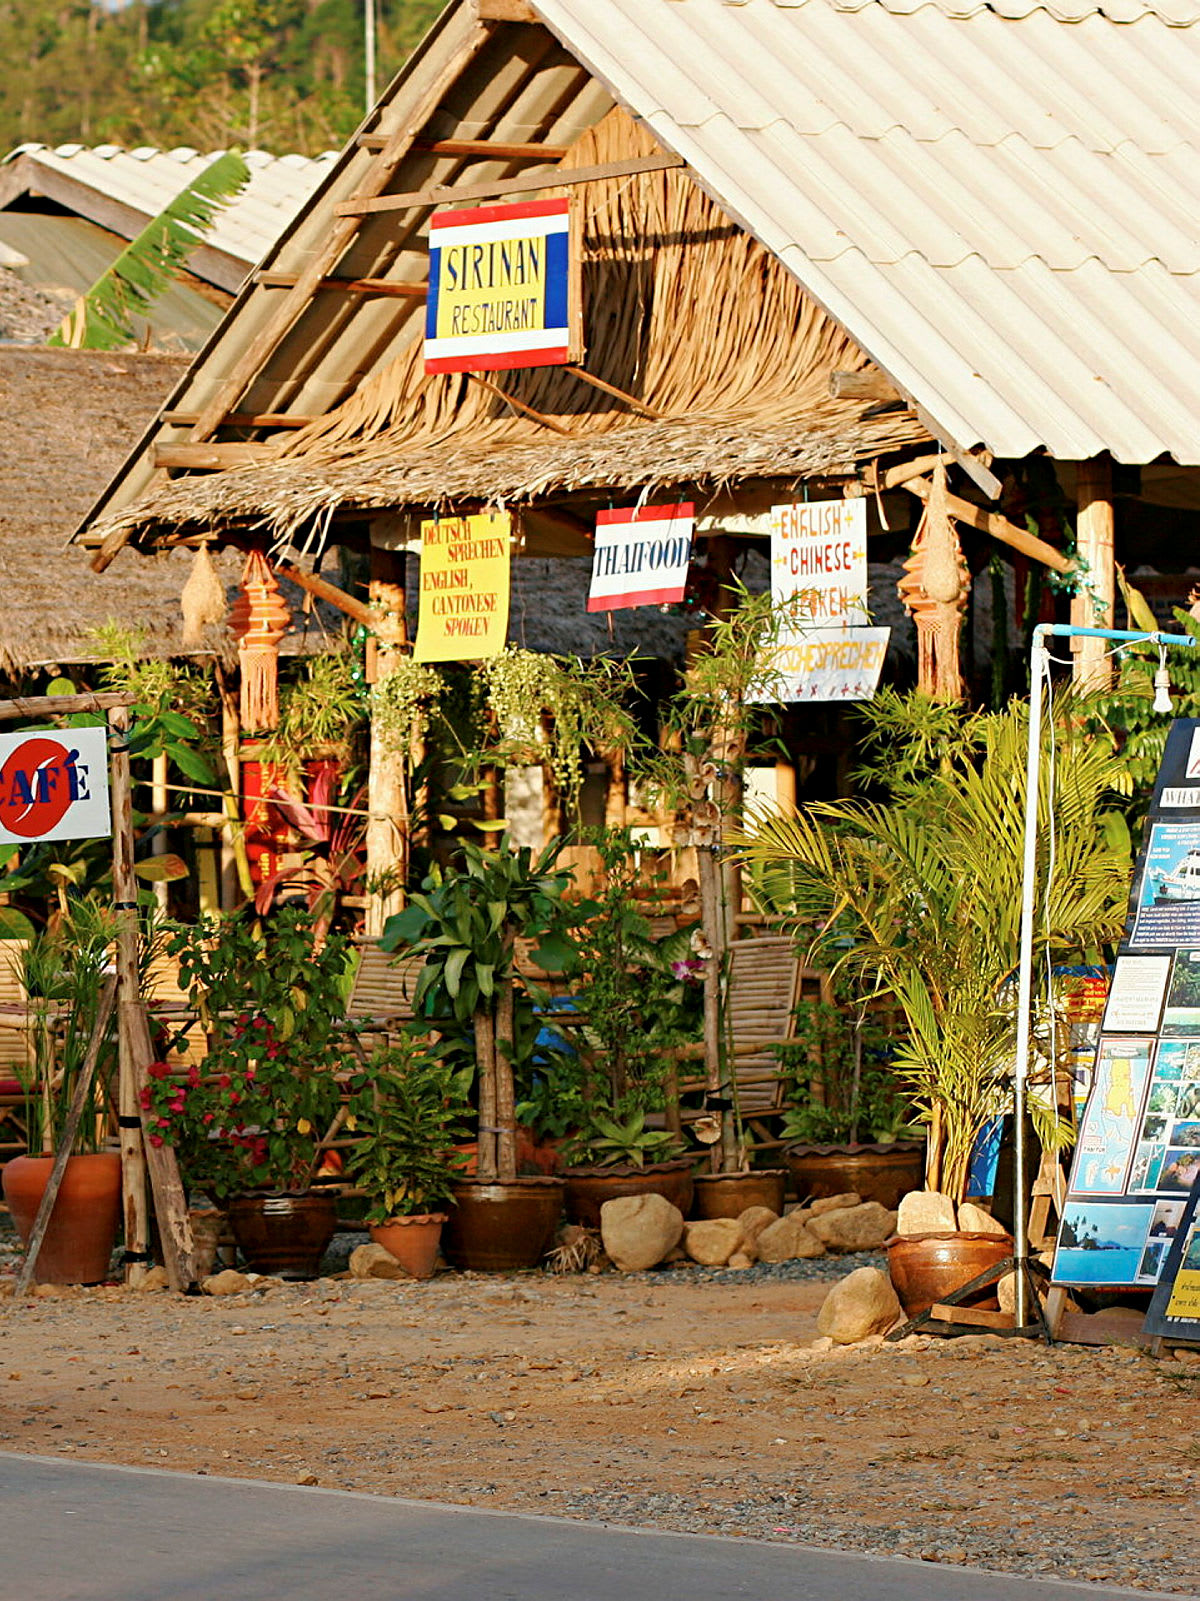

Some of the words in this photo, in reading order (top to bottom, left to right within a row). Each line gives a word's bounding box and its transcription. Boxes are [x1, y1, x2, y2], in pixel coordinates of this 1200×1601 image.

[446, 236, 540, 292] SIRINAN
[452, 297, 537, 335] RESTAURANT
[423, 521, 472, 546] DEUTSCH
[781, 505, 841, 539] ENGLISH
[447, 538, 505, 562] SPRECHEN
[791, 542, 852, 575] CHINESE
[432, 592, 497, 616] CANTONESE
[444, 616, 490, 637] SPOKEN
